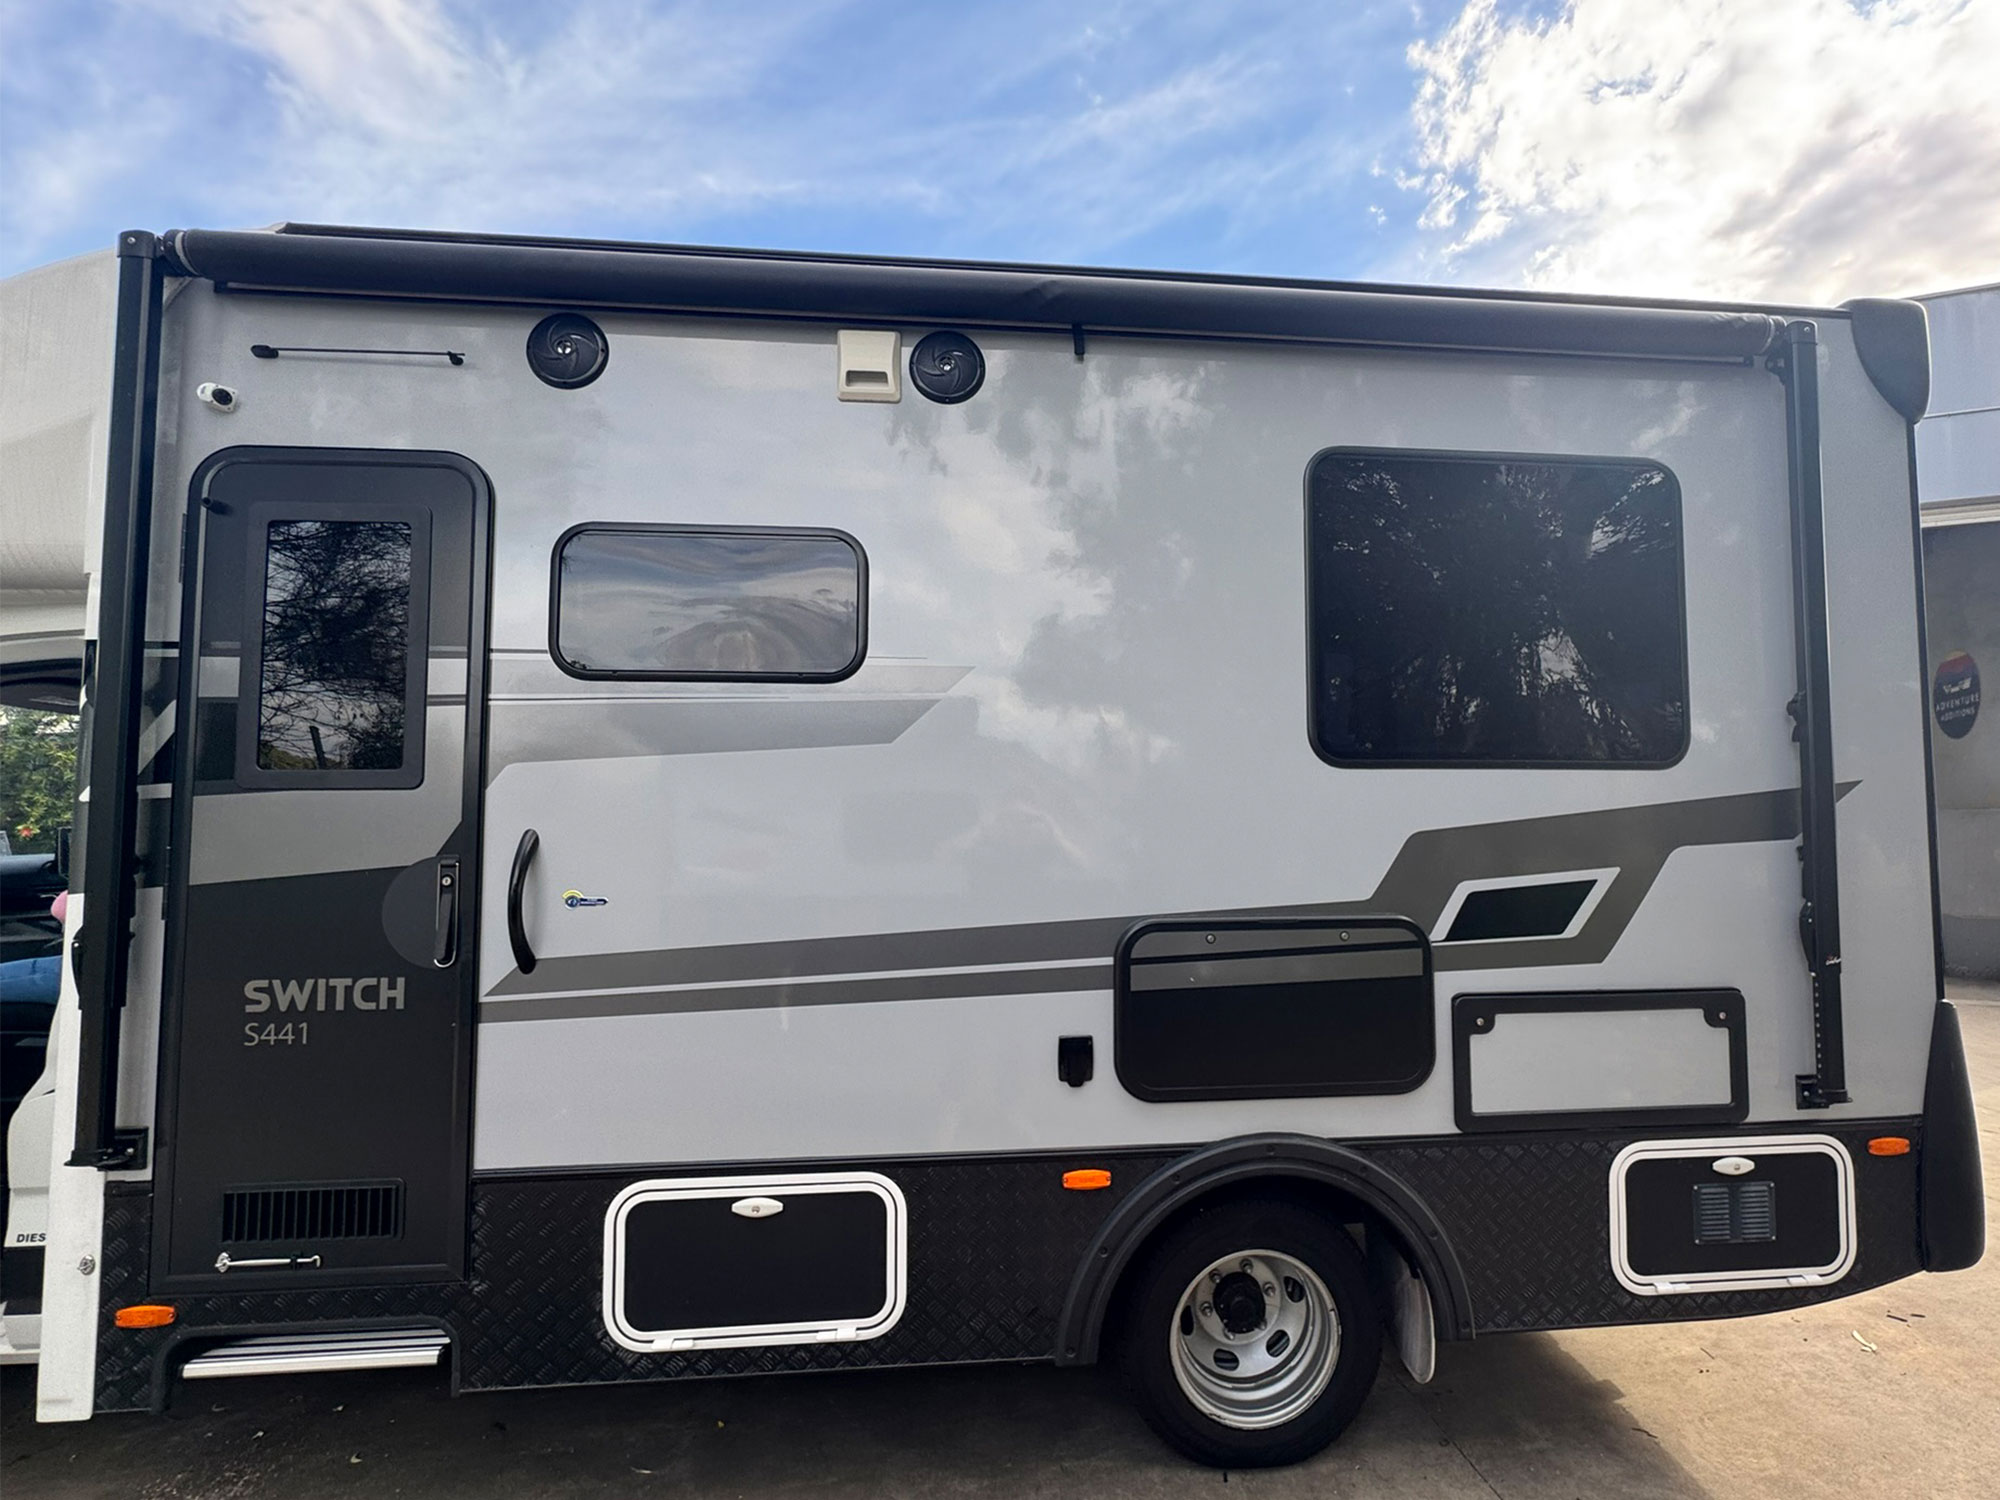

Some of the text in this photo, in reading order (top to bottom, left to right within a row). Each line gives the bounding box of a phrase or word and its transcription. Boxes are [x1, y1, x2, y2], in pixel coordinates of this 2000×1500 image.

[1935, 692, 1980, 712] ADVENTURE
[243, 976, 406, 1013] SWITCH
[243, 1022, 308, 1047] S441
